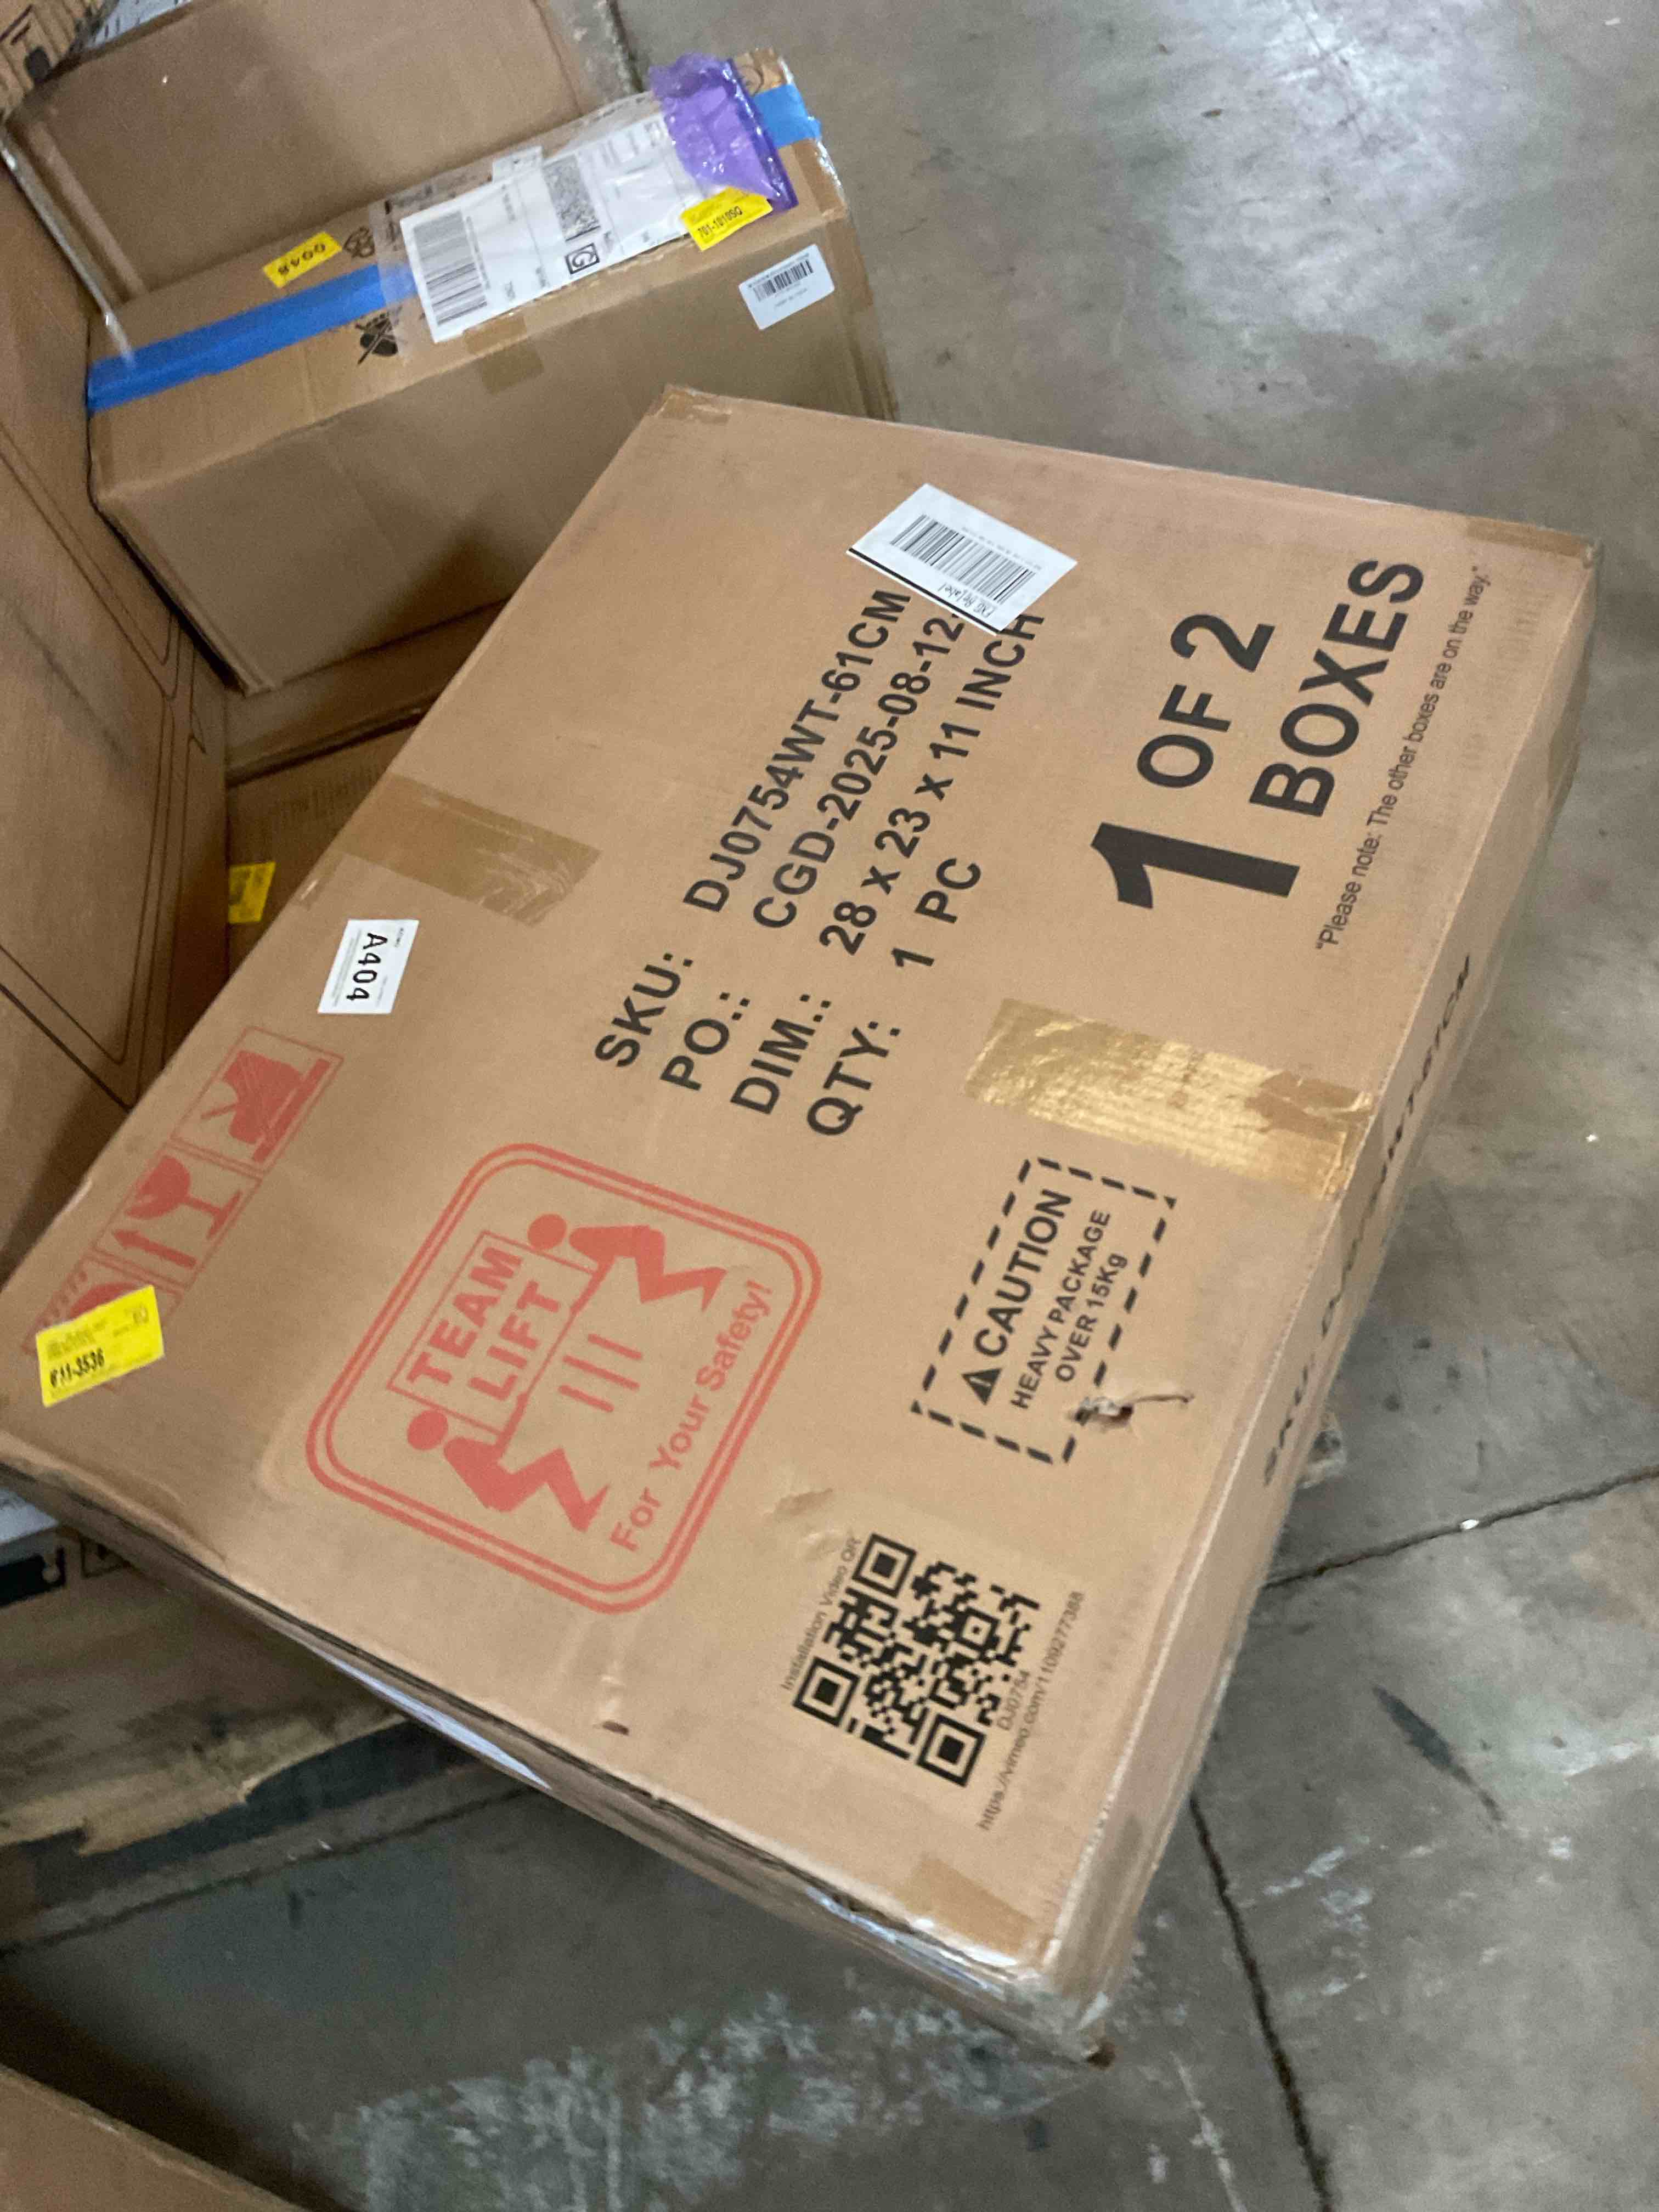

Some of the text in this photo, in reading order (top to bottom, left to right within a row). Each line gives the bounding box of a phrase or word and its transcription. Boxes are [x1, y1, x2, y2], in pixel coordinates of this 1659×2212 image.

[956, 613, 1045, 711] INCH
[1442, 639, 1463, 659] on
[1448, 610, 1474, 635] the
[1249, 558, 1424, 817] BOXES
[1402, 693, 1440, 742] boxes
[1429, 662, 1452, 690] are
[929, 721, 981, 758] 11
[1091, 613, 1300, 910] 1 OF 2
[1388, 746, 1417, 791] other
[595, 589, 911, 1067] SKU: DJ0754WT-61CM
[915, 772, 955, 801] x
[1367, 794, 1398, 826] The
[874, 807, 931, 859] 23
[1352, 832, 1383, 877] note:
[860, 865, 901, 895] x
[346, 933, 388, 1001] A404
[819, 900, 878, 956] 28
[806, 857, 983, 1137] QTY: 1 PC
[730, 994, 832, 1115] DIM.:
[973, 1189, 1072, 1358] CAUTION
[1009, 1209, 1111, 1409] HEAVY PACKAGE
[407, 1246, 523, 1387] TEAM
[467, 1279, 562, 1401] LIFT
[1054, 1252, 1128, 1383] OVER 15Kg
[610, 1278, 774, 1553] For Your Safety!
[780, 1611, 828, 1691] Installation
[819, 1565, 848, 1606] Video
